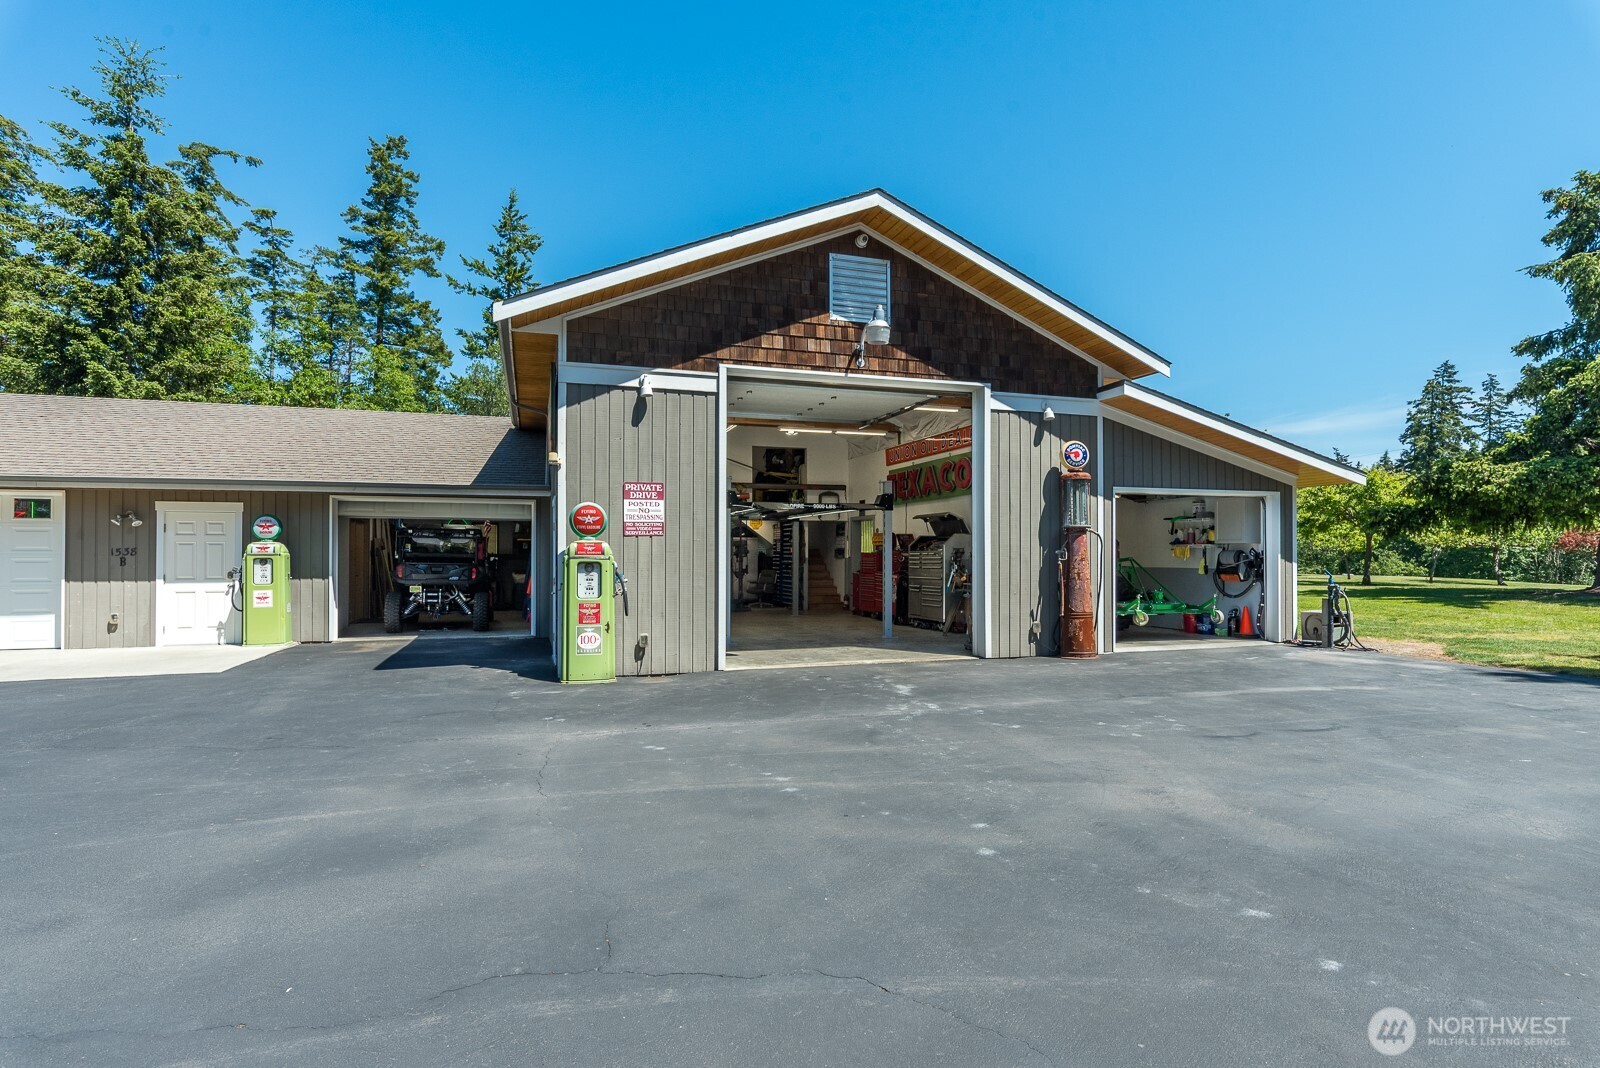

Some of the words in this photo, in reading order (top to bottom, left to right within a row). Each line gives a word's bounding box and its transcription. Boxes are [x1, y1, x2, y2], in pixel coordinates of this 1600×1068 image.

[889, 443, 917, 463] UNION
[920, 437, 938, 454] OIL
[941, 428, 972, 450] DEAL
[887, 457, 972, 500] TEXACO
[625, 483, 662, 491] PRIVATE
[630, 491, 658, 499] DRIVE
[111, 547, 137, 556] 1538
[119, 556, 127, 566] B
